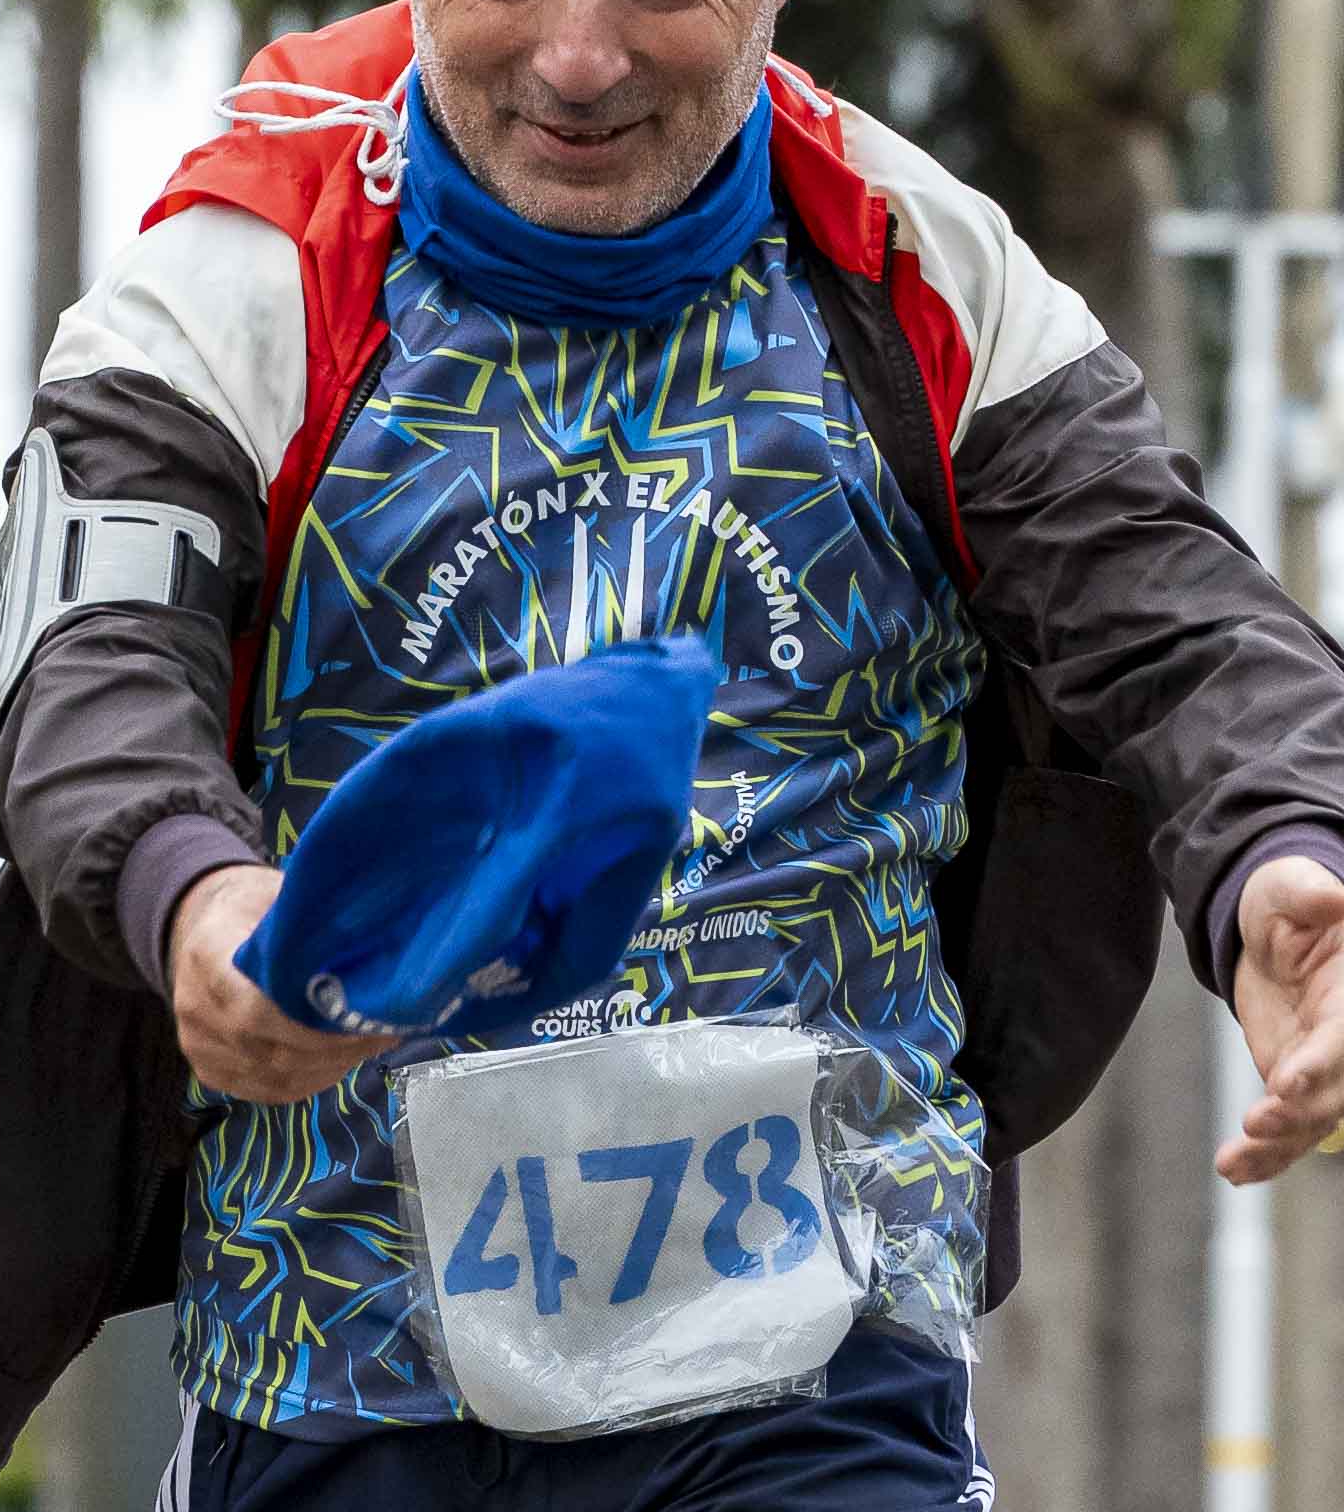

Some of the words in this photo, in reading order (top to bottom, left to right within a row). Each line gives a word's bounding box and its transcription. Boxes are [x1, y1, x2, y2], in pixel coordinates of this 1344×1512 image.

[401, 482, 566, 664] MARATÓN
[576, 472, 611, 507] X
[626, 473, 670, 512] EL
[679, 489, 803, 670] AUTISMO
[720, 770, 756, 855] POSITIVA
[701, 909, 772, 942] UNIDOS
[531, 1018, 603, 1037] COURS
[444, 1115, 822, 1316] 478
